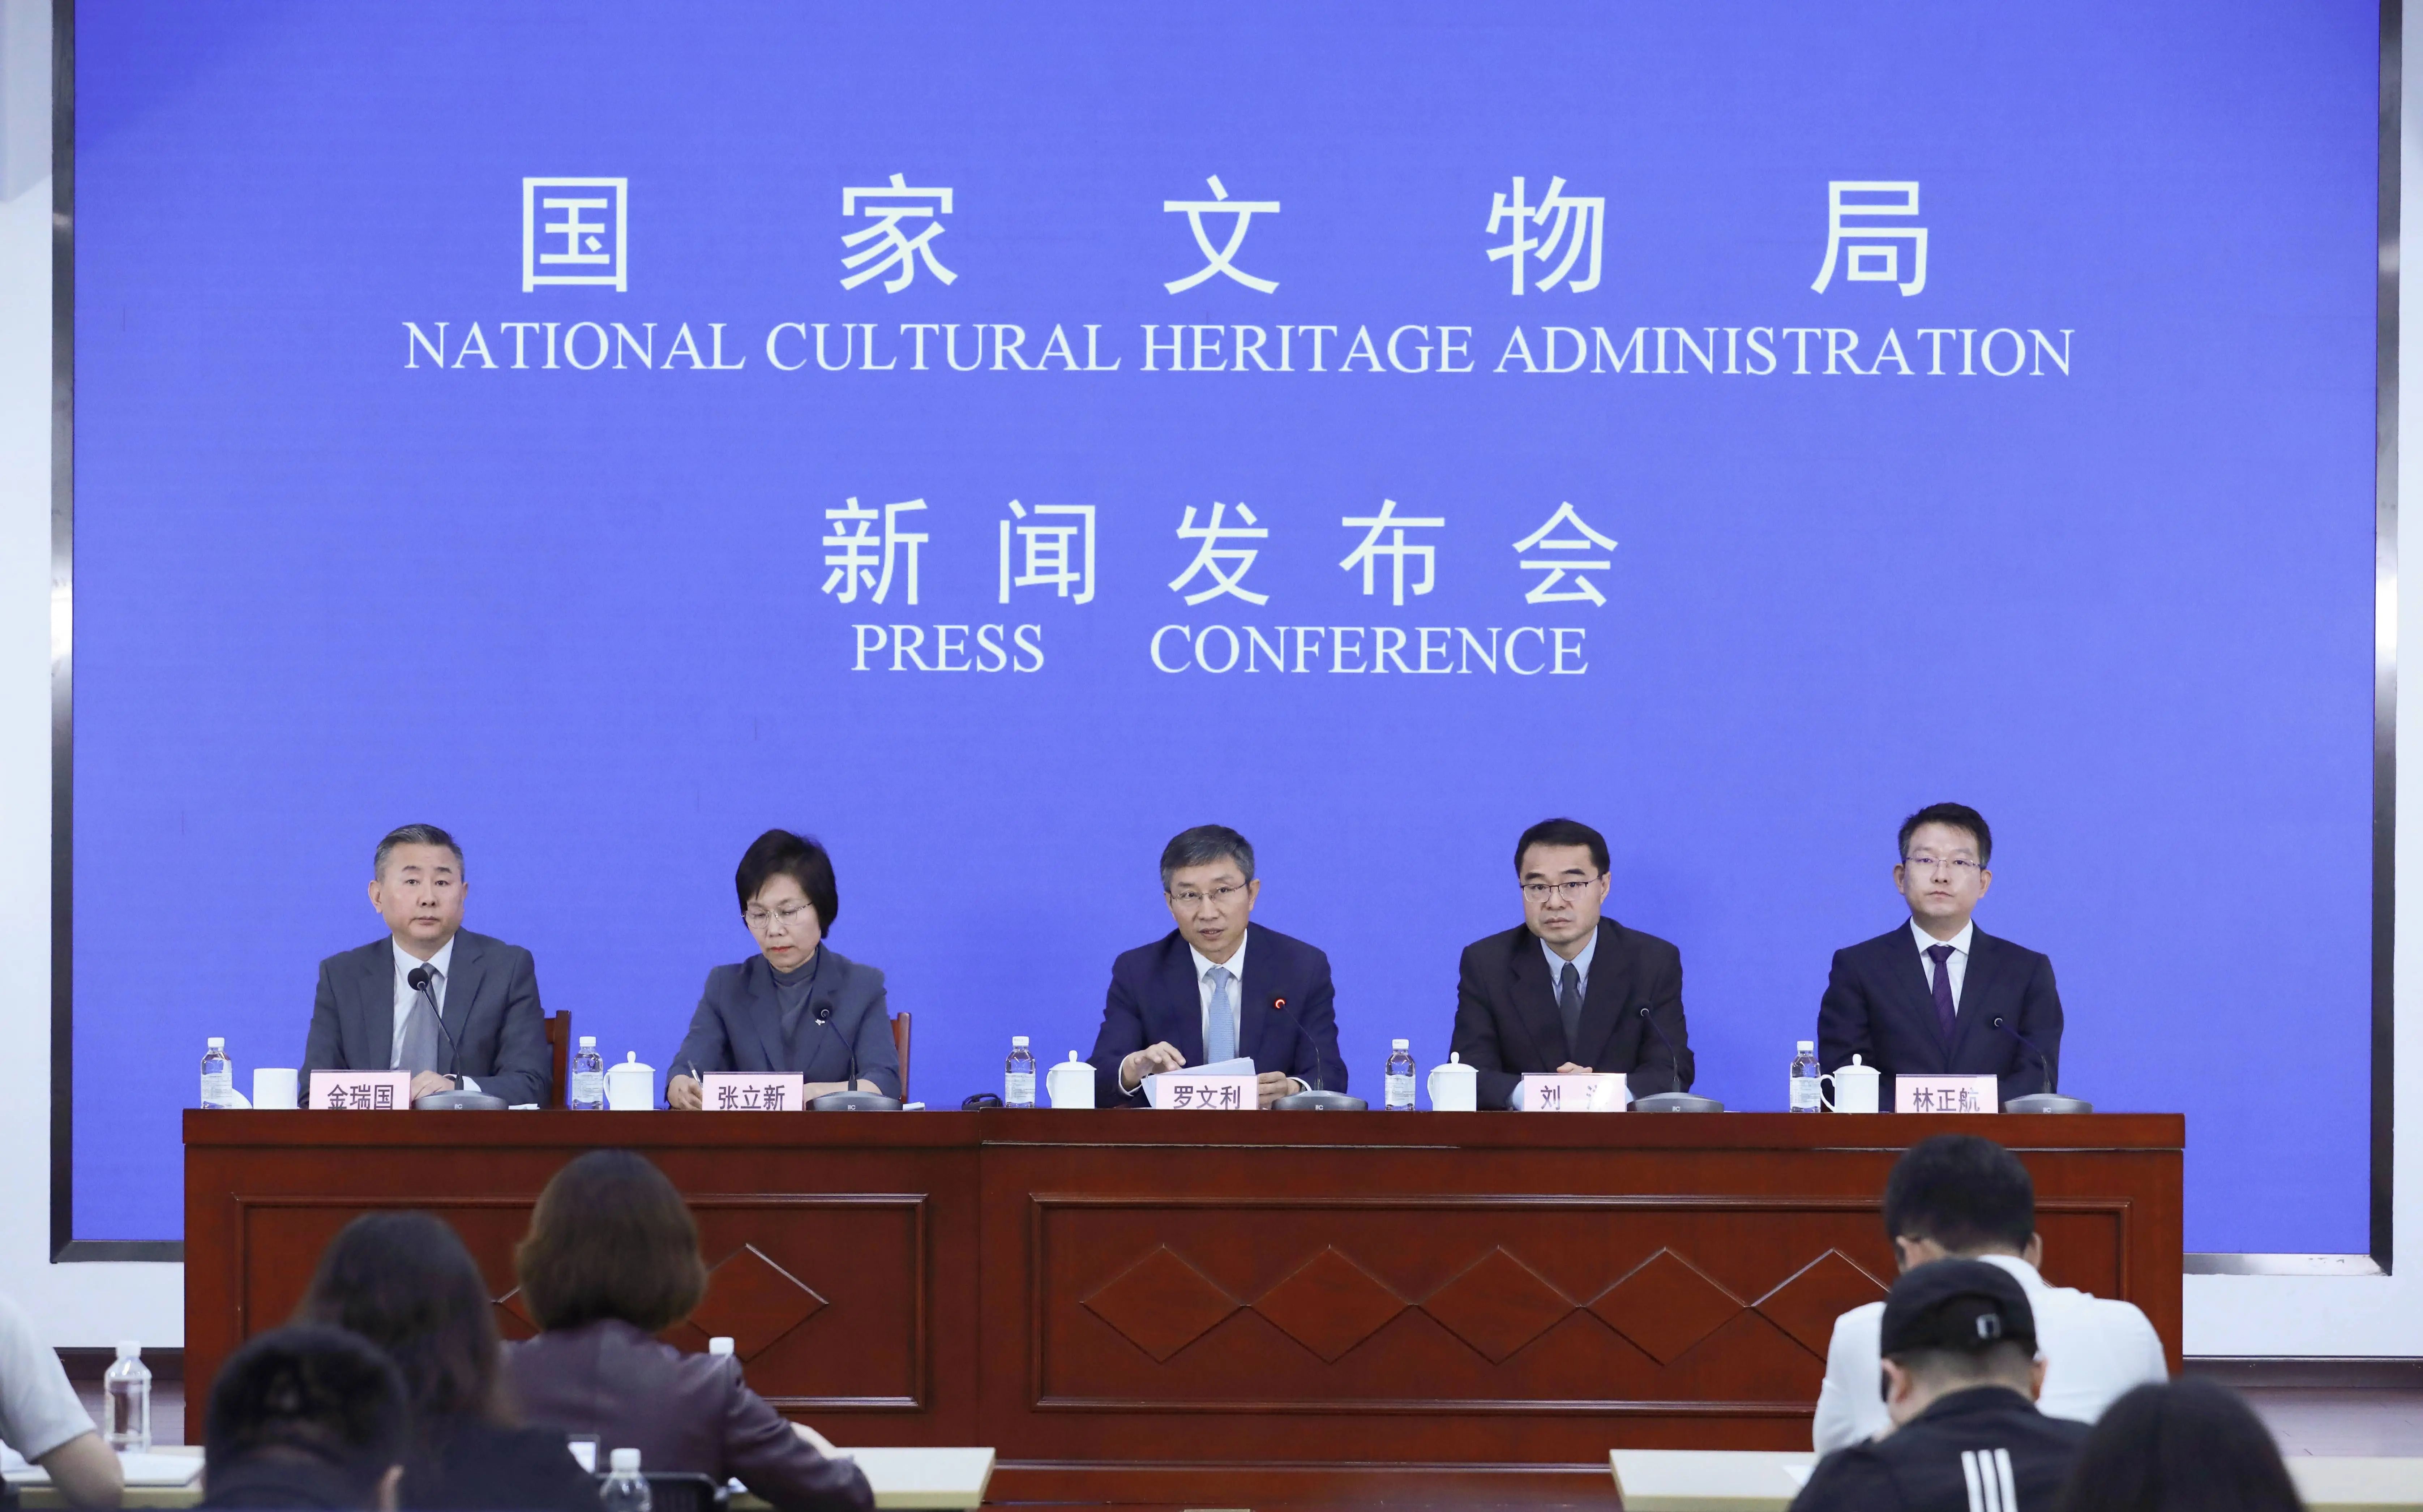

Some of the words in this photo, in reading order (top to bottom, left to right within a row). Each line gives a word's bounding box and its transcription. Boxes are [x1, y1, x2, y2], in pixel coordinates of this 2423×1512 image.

[522, 172, 1928, 297] 国家文物局
[402, 321, 745, 371] NATIONAL
[766, 322, 1121, 372] CULTURAL
[1140, 324, 1474, 373] HERITAGE
[1493, 325, 2075, 377] ADMINISTRATION
[821, 496, 1618, 607] 新闻发布会
[851, 624, 1044, 673] PRESS
[1150, 625, 1588, 675] CONFERENCE
[327, 1084, 394, 1109] 金瑞国
[718, 1084, 785, 1111] 张立新
[1173, 1085, 1241, 1110] 罗文利
[1913, 1087, 1980, 1112] 林正航
